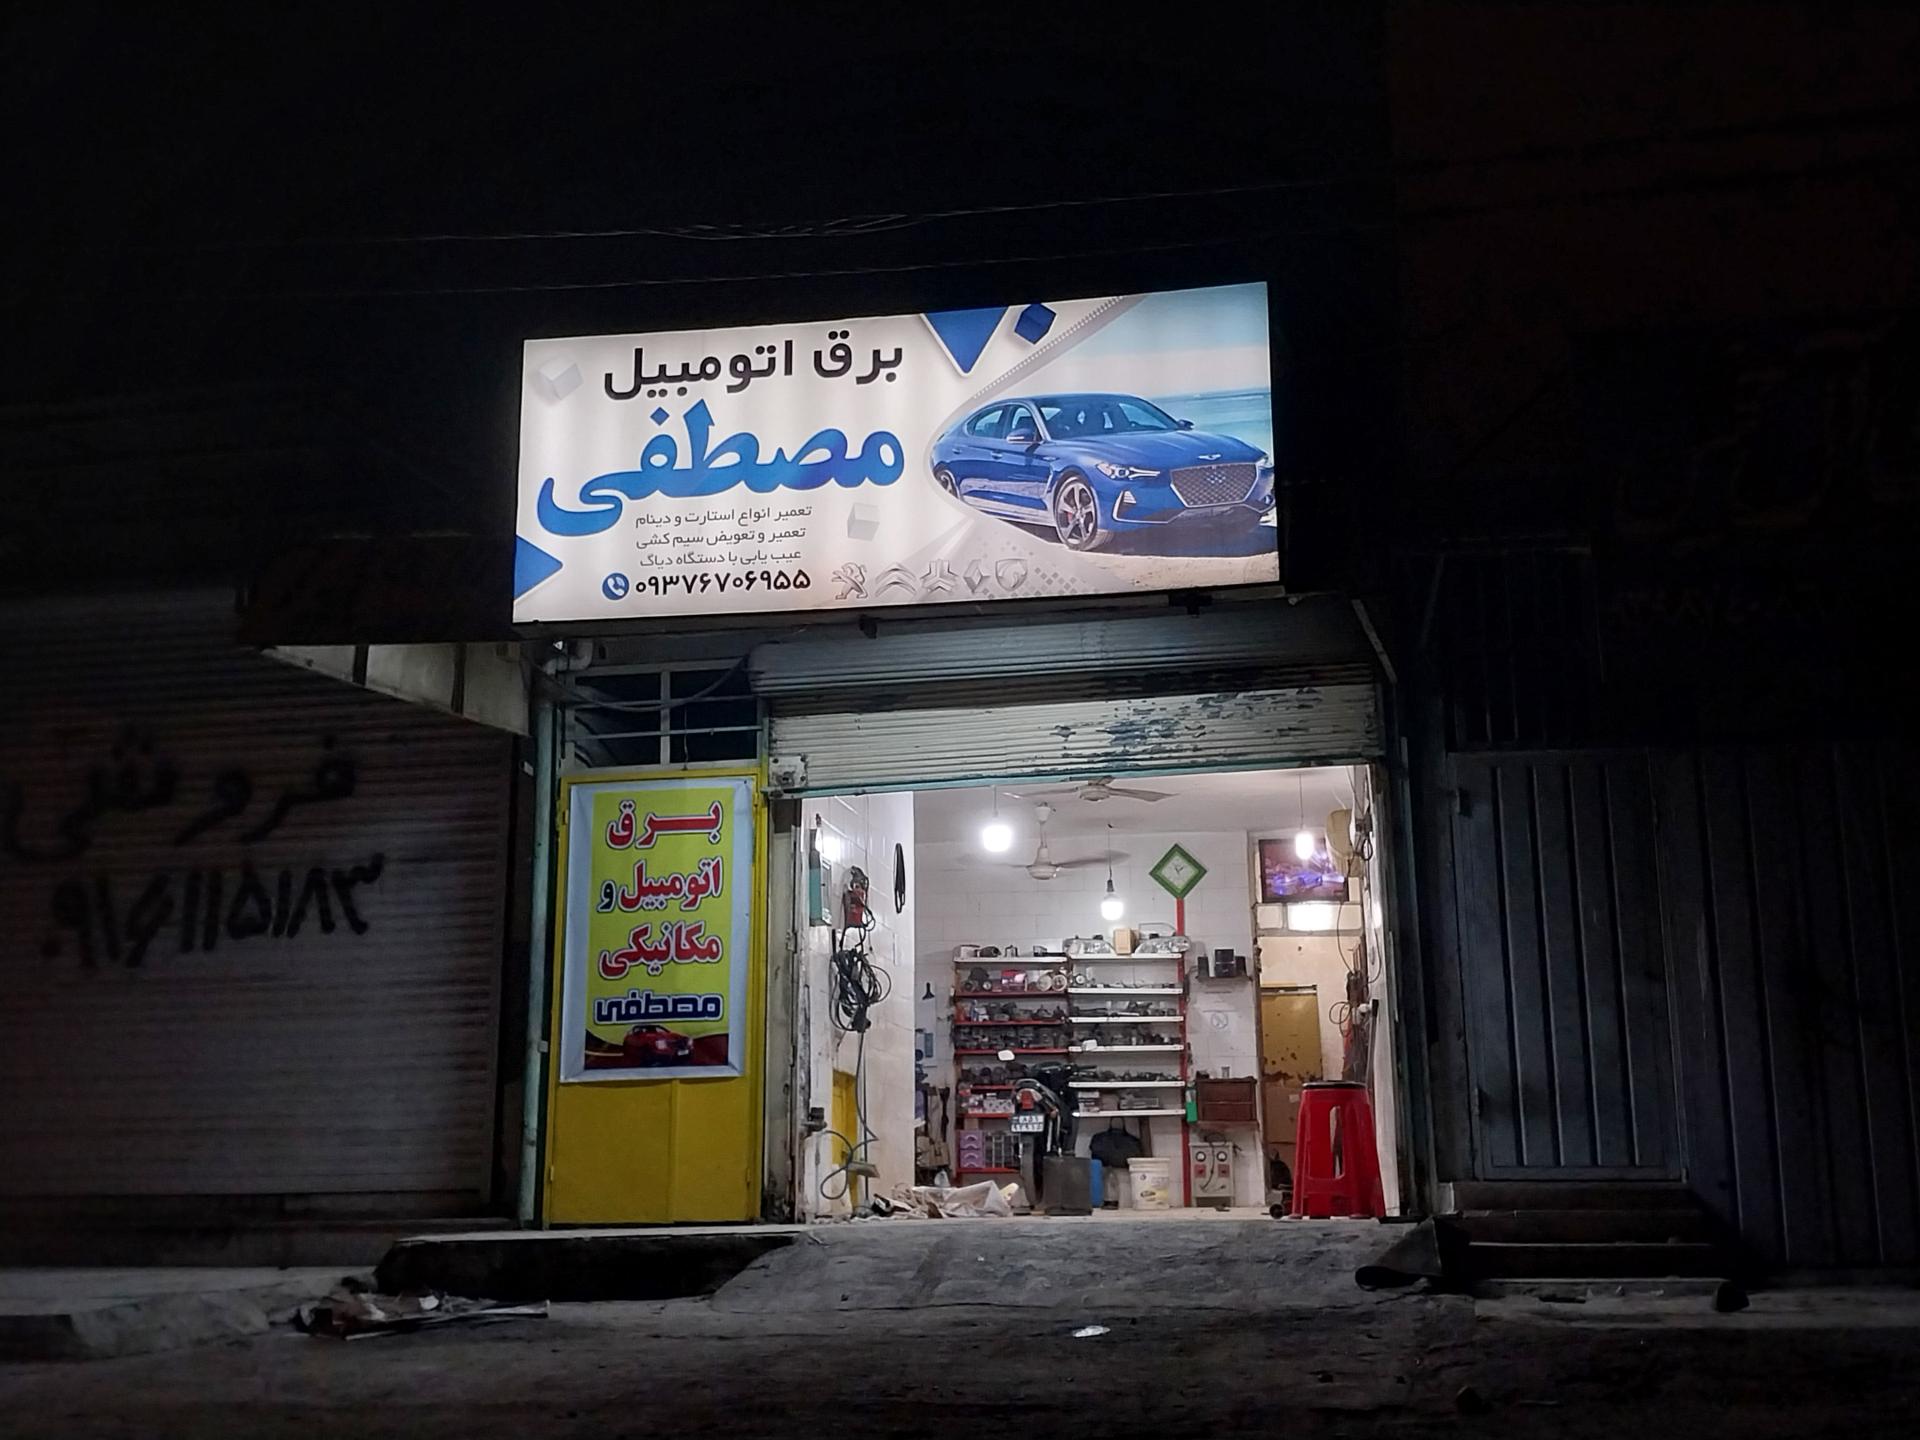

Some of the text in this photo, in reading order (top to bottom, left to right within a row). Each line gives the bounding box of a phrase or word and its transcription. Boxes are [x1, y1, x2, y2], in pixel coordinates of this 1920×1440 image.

[603, 329, 903, 401] برق اتومبیل
[536, 398, 905, 536] مصطفی
[635, 505, 812, 528] تعمیر انواع استارت و دینام
[636, 527, 806, 550] تعمیر و تعویض سیم کشی
[675, 552, 725, 566] دستگاه
[728, 551, 738, 566] با
[740, 550, 768, 566] یابی
[770, 550, 801, 564] عیب
[635, 569, 812, 596] ۰۹۳۷۶۷۰۶۹۵۵
[606, 799, 722, 849] برق
[597, 856, 723, 912] اتومبیل و
[599, 920, 723, 979] مکانیکی
[594, 989, 723, 1024] مصطفی
